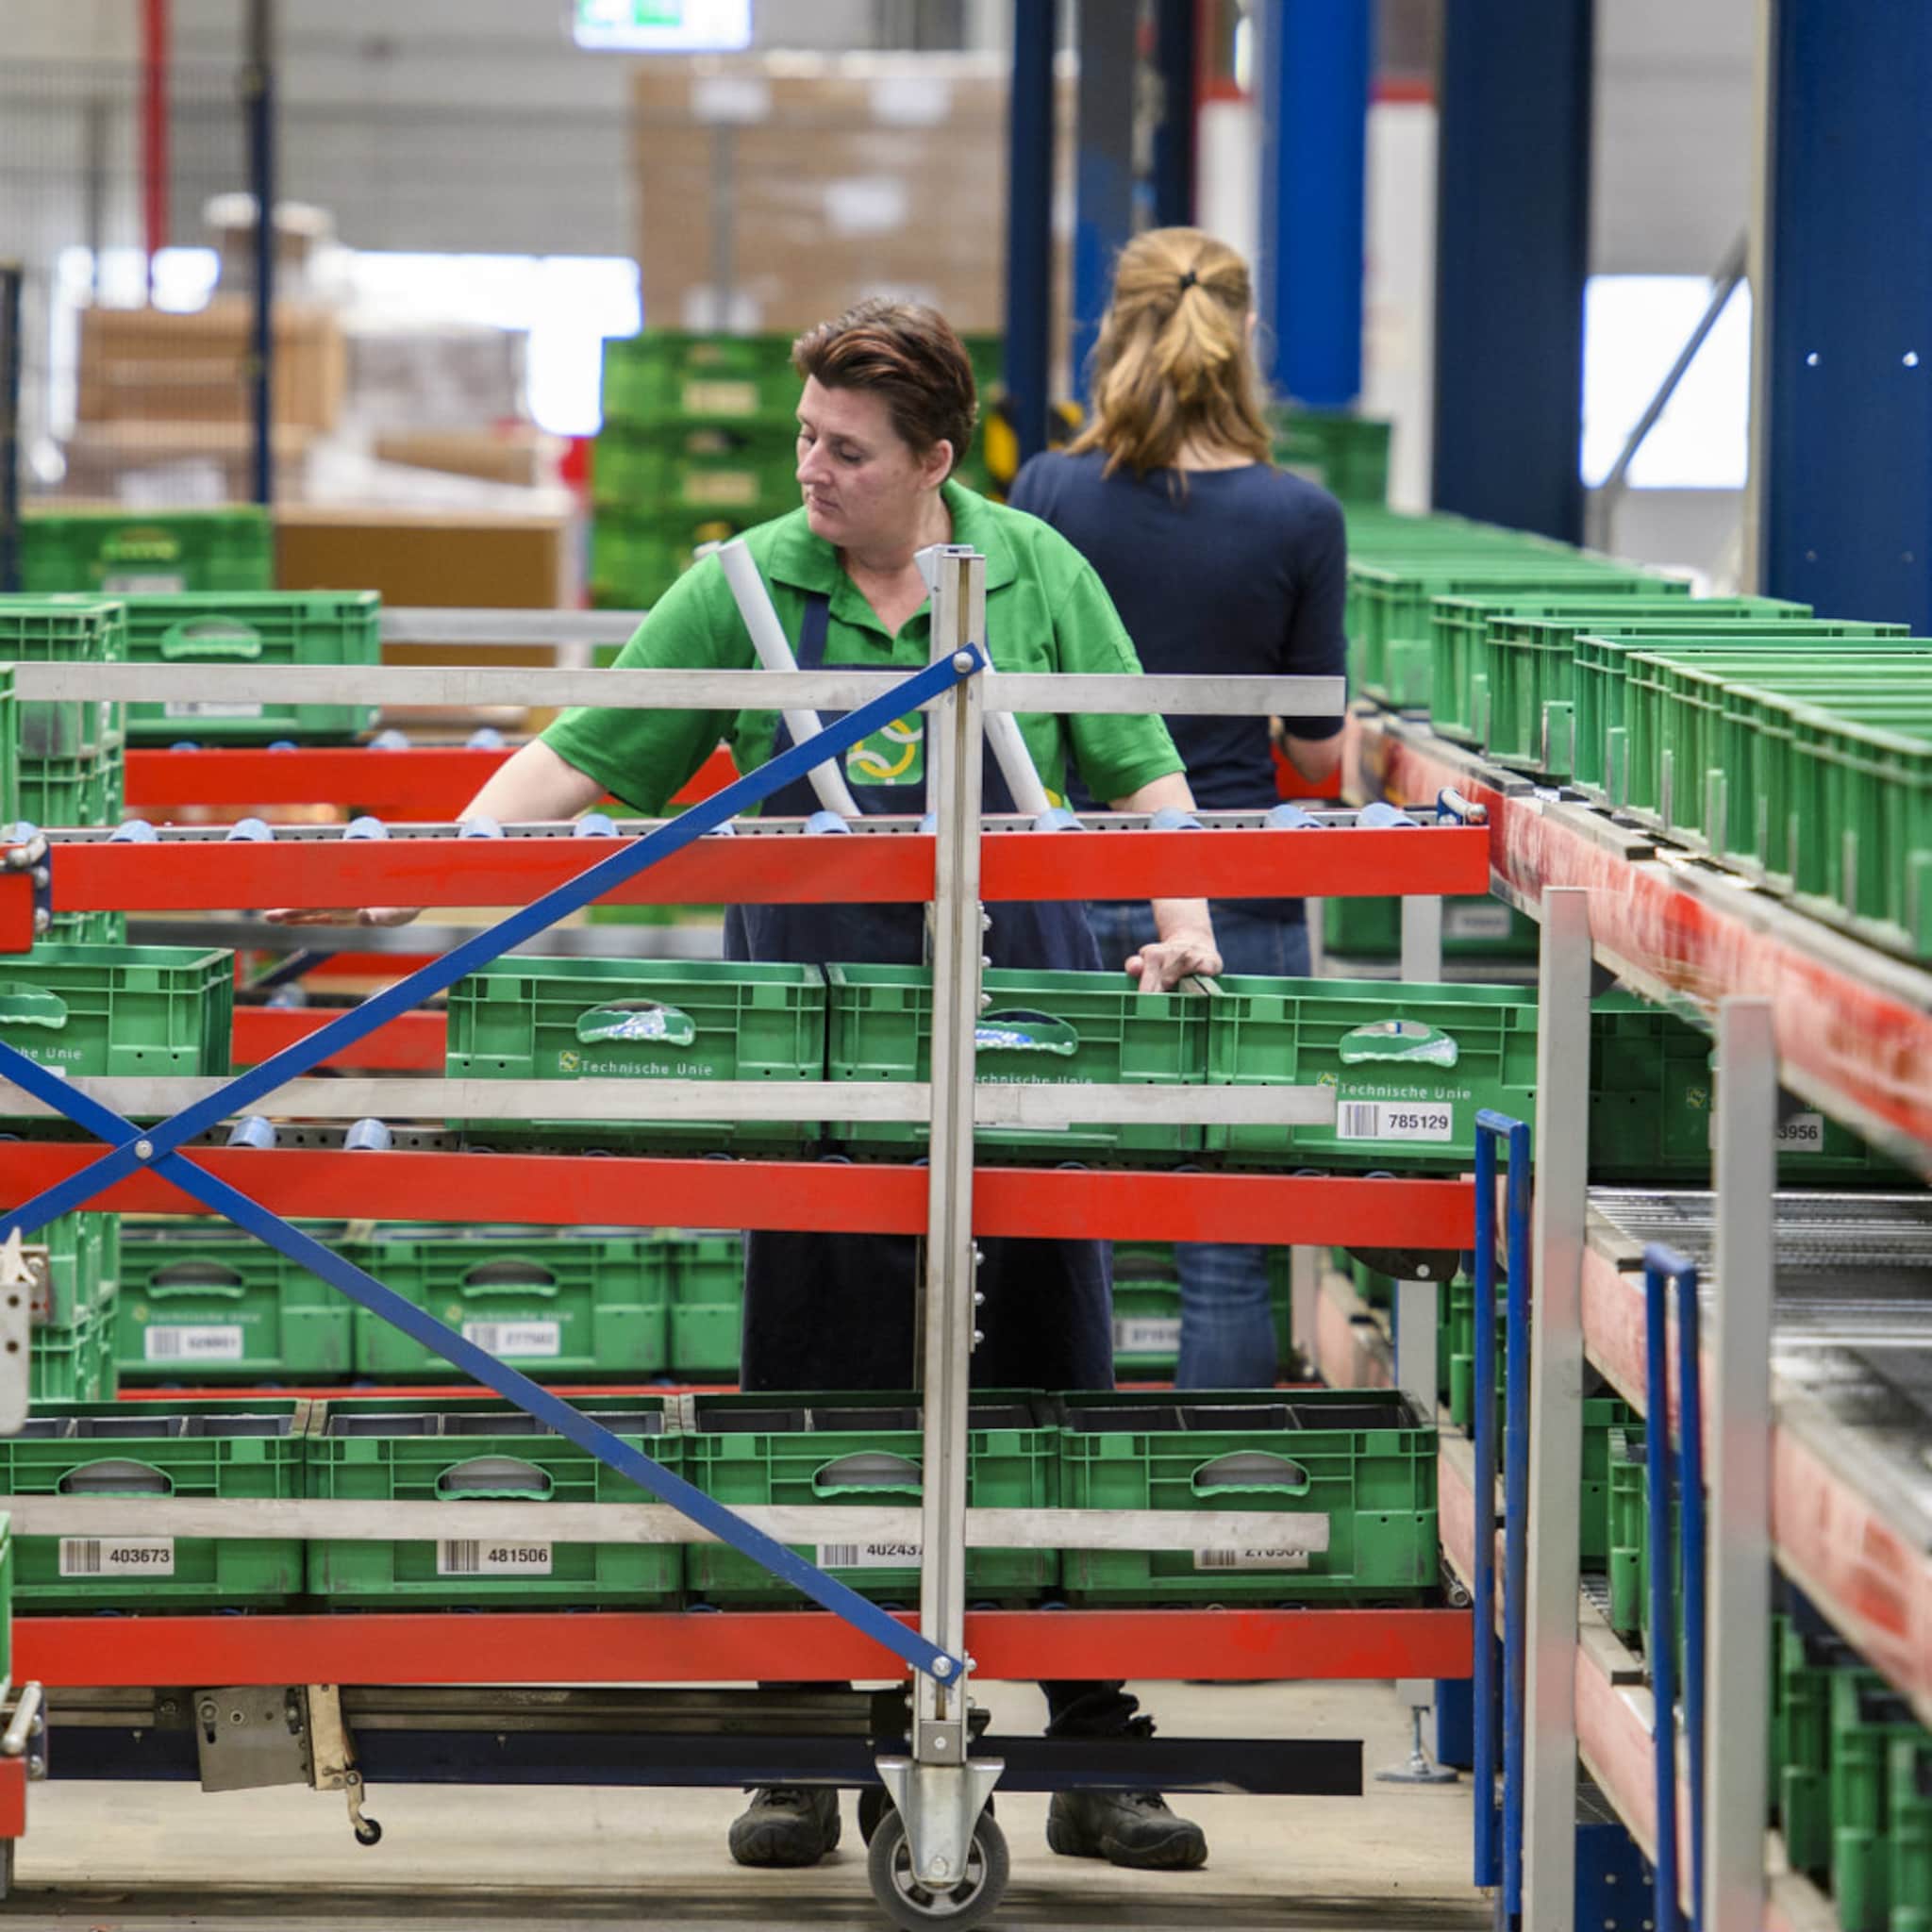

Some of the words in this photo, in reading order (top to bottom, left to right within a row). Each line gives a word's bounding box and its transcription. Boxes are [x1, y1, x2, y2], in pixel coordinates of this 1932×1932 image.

[581, 1059, 670, 1074] Technische
[676, 1062, 713, 1075] Unie
[975, 1074, 1051, 1085] chnische
[1341, 1083, 1428, 1099] Technische
[1434, 1087, 1473, 1100] Unie
[1388, 1113, 1449, 1130] 785129
[1777, 1124, 1819, 1141] 3956
[109, 1548, 170, 1563] 403673
[488, 1548, 548, 1563] 481506
[866, 1544, 924, 1557] 40243
